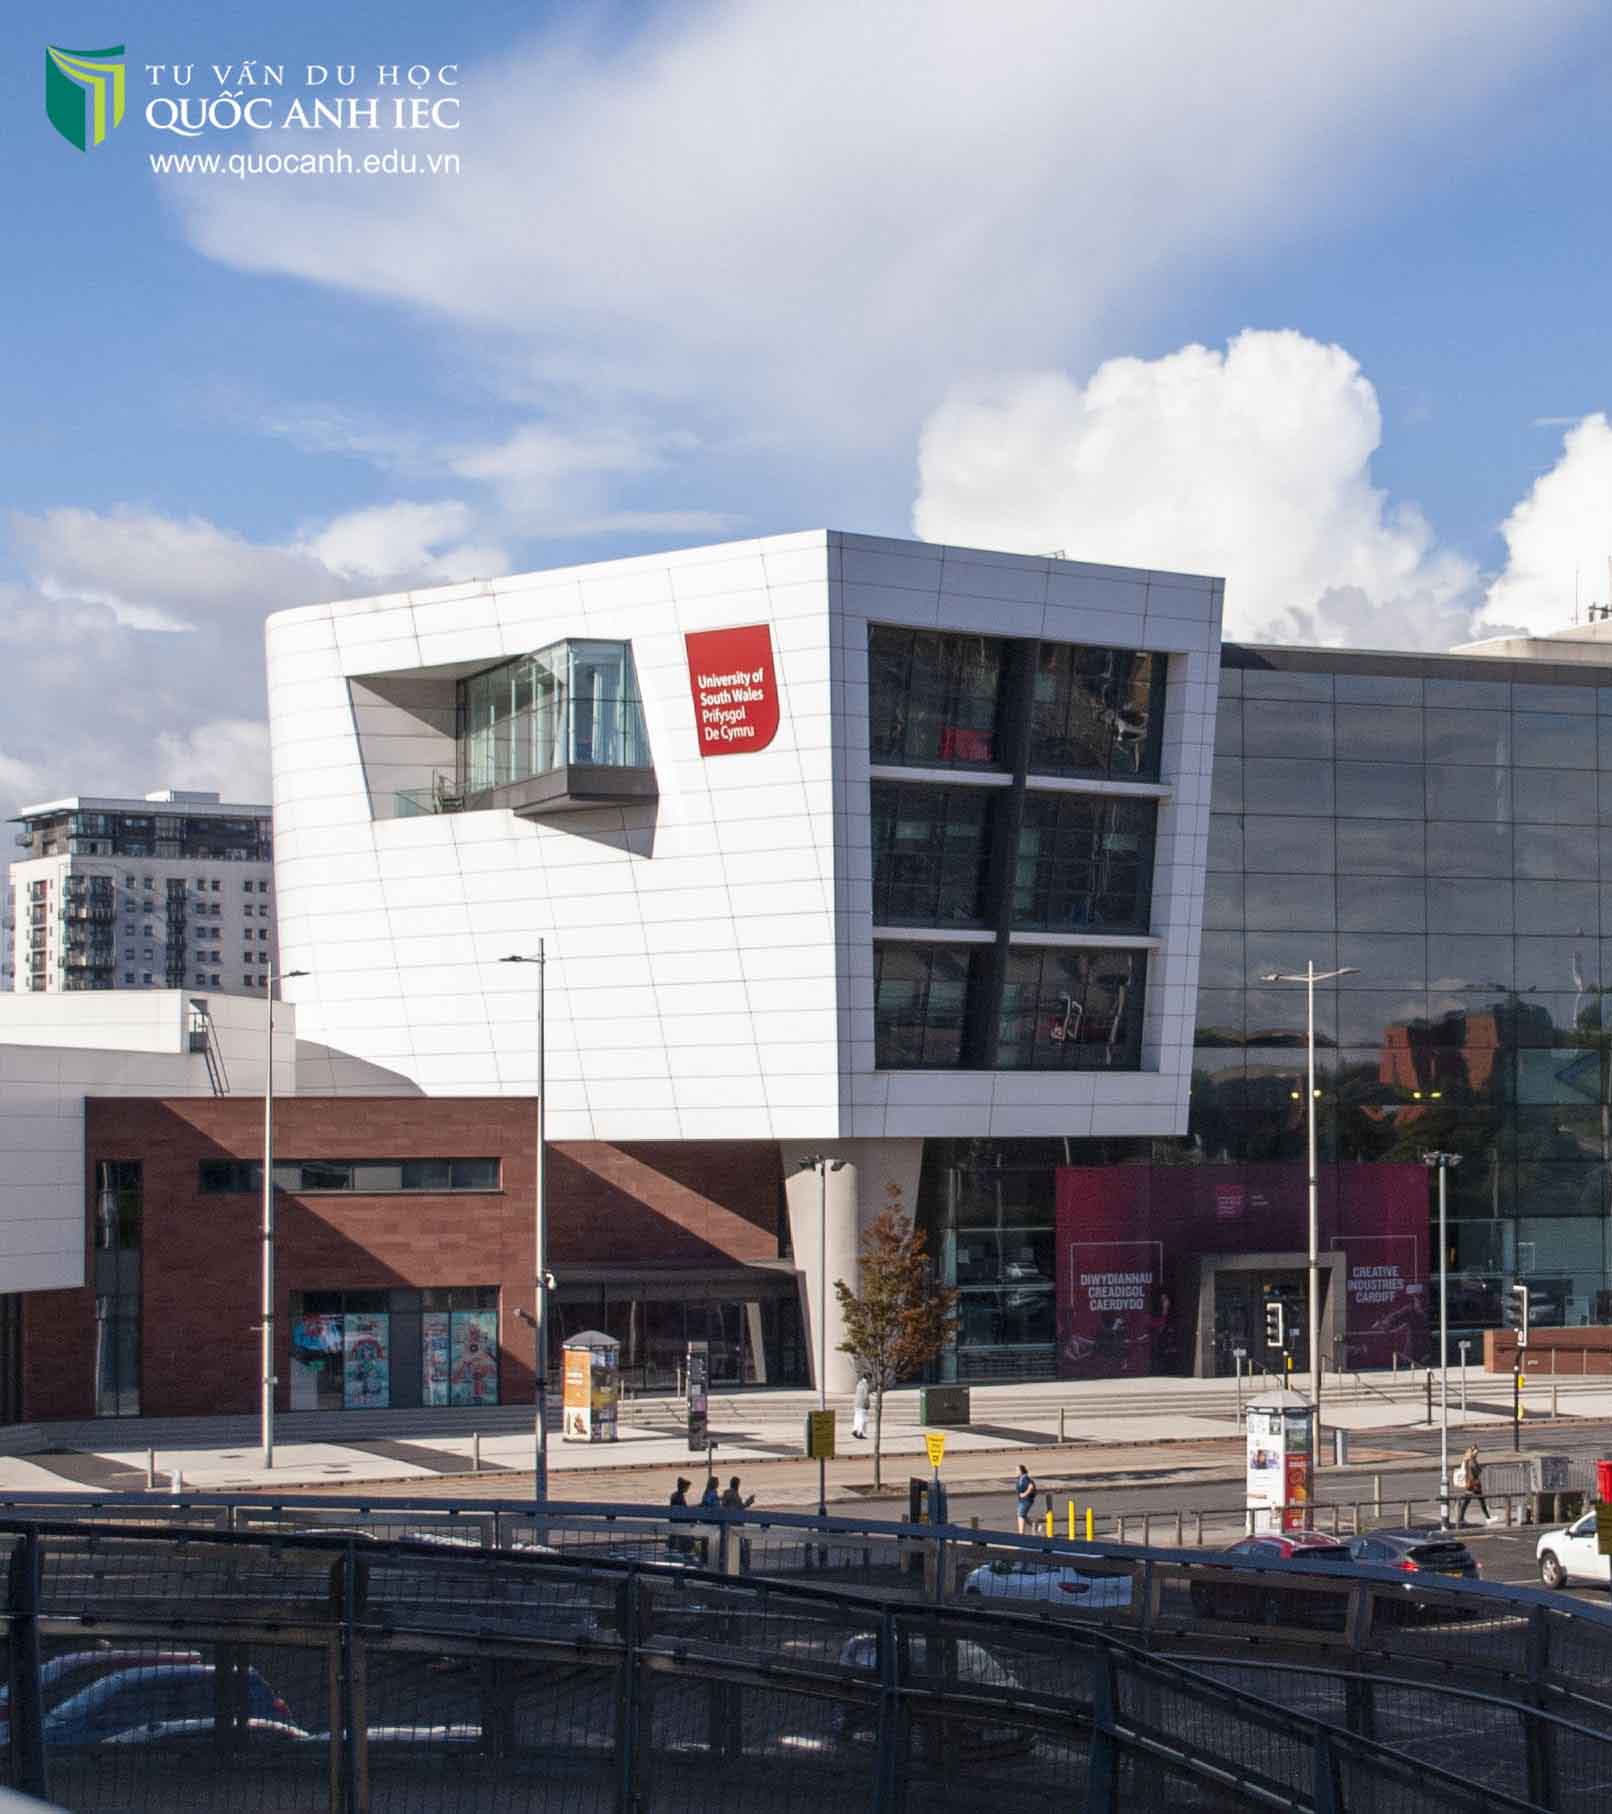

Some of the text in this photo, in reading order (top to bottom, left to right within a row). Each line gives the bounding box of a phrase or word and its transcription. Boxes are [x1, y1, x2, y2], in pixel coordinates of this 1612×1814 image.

[697, 667, 764, 689] University of
[700, 686, 764, 706] South Wales
[702, 705, 746, 726] Prifysgol
[704, 725, 755, 743] De Cymru
[1352, 1265, 1400, 1278] CREATIVE
[1080, 1272, 1153, 1286] DIWYDIANNAU
[1347, 1278, 1405, 1292] INDUSTRIES
[1087, 1286, 1145, 1299] CREADIGOL
[1355, 1291, 1396, 1304] CARDIFF
[1089, 1298, 1144, 1311] CAERDYDD
